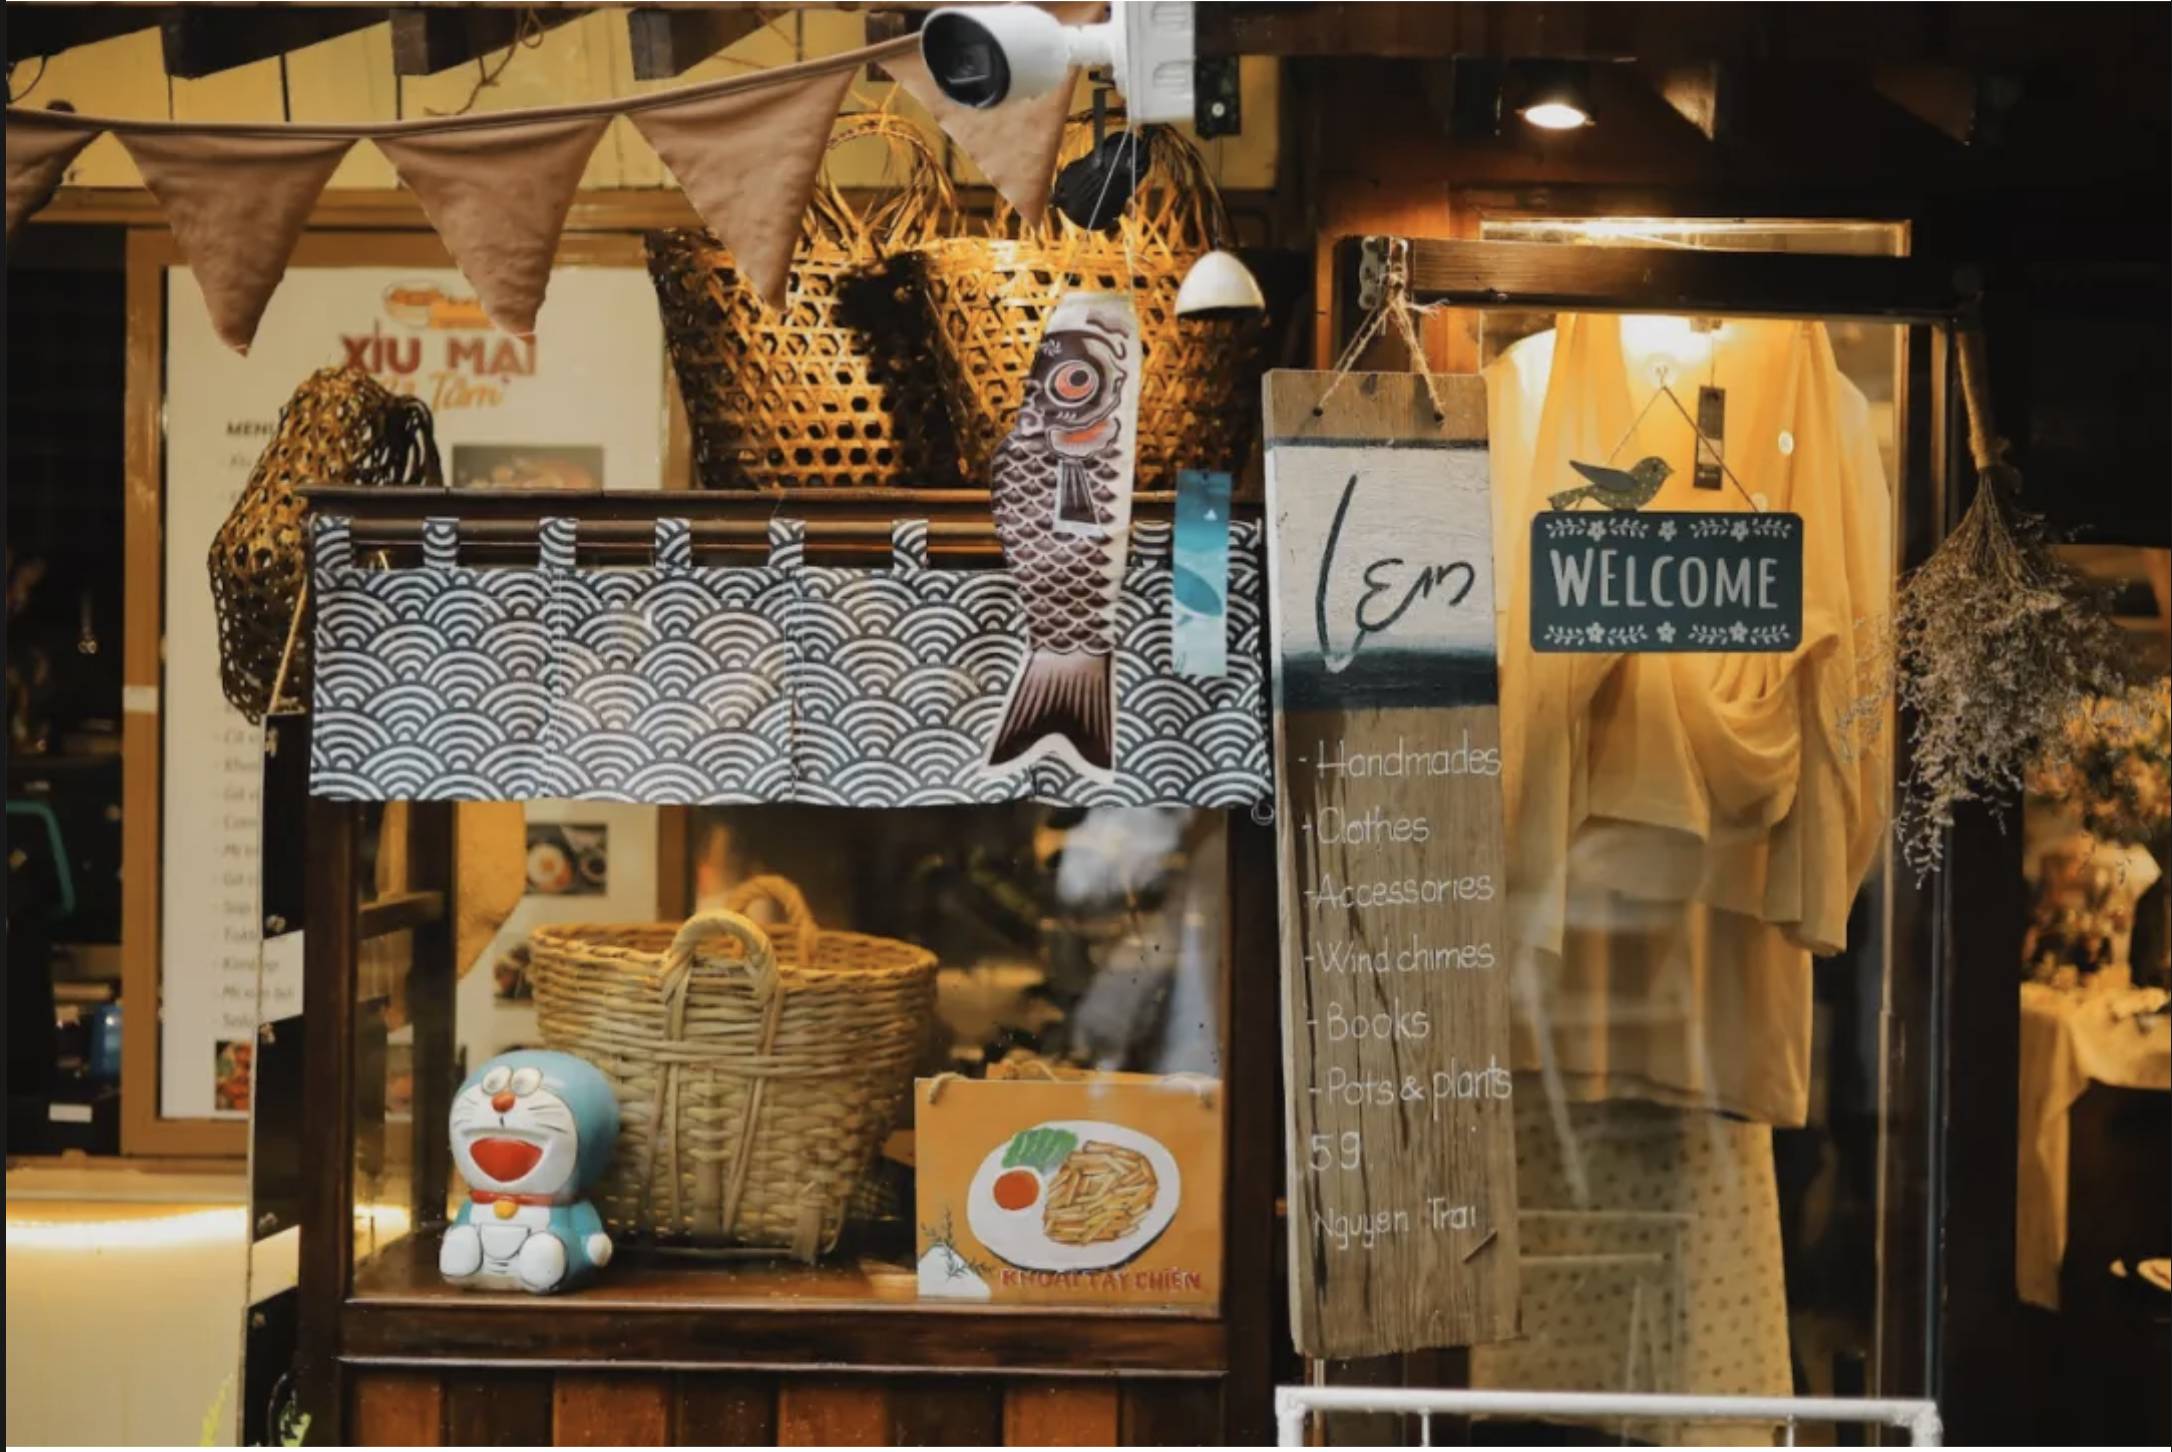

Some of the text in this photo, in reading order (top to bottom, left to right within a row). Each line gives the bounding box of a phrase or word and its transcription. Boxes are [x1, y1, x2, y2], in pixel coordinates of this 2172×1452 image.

[1550, 547, 1779, 609] WELCOME
[1317, 729, 1502, 778] Handmades
[1317, 805, 1430, 844] Clothes
[1314, 873, 1495, 910] Accessories
[1327, 997, 1430, 1041] Books
[1327, 1066, 1394, 1105] Pots
[1433, 1053, 1513, 1122] plants
